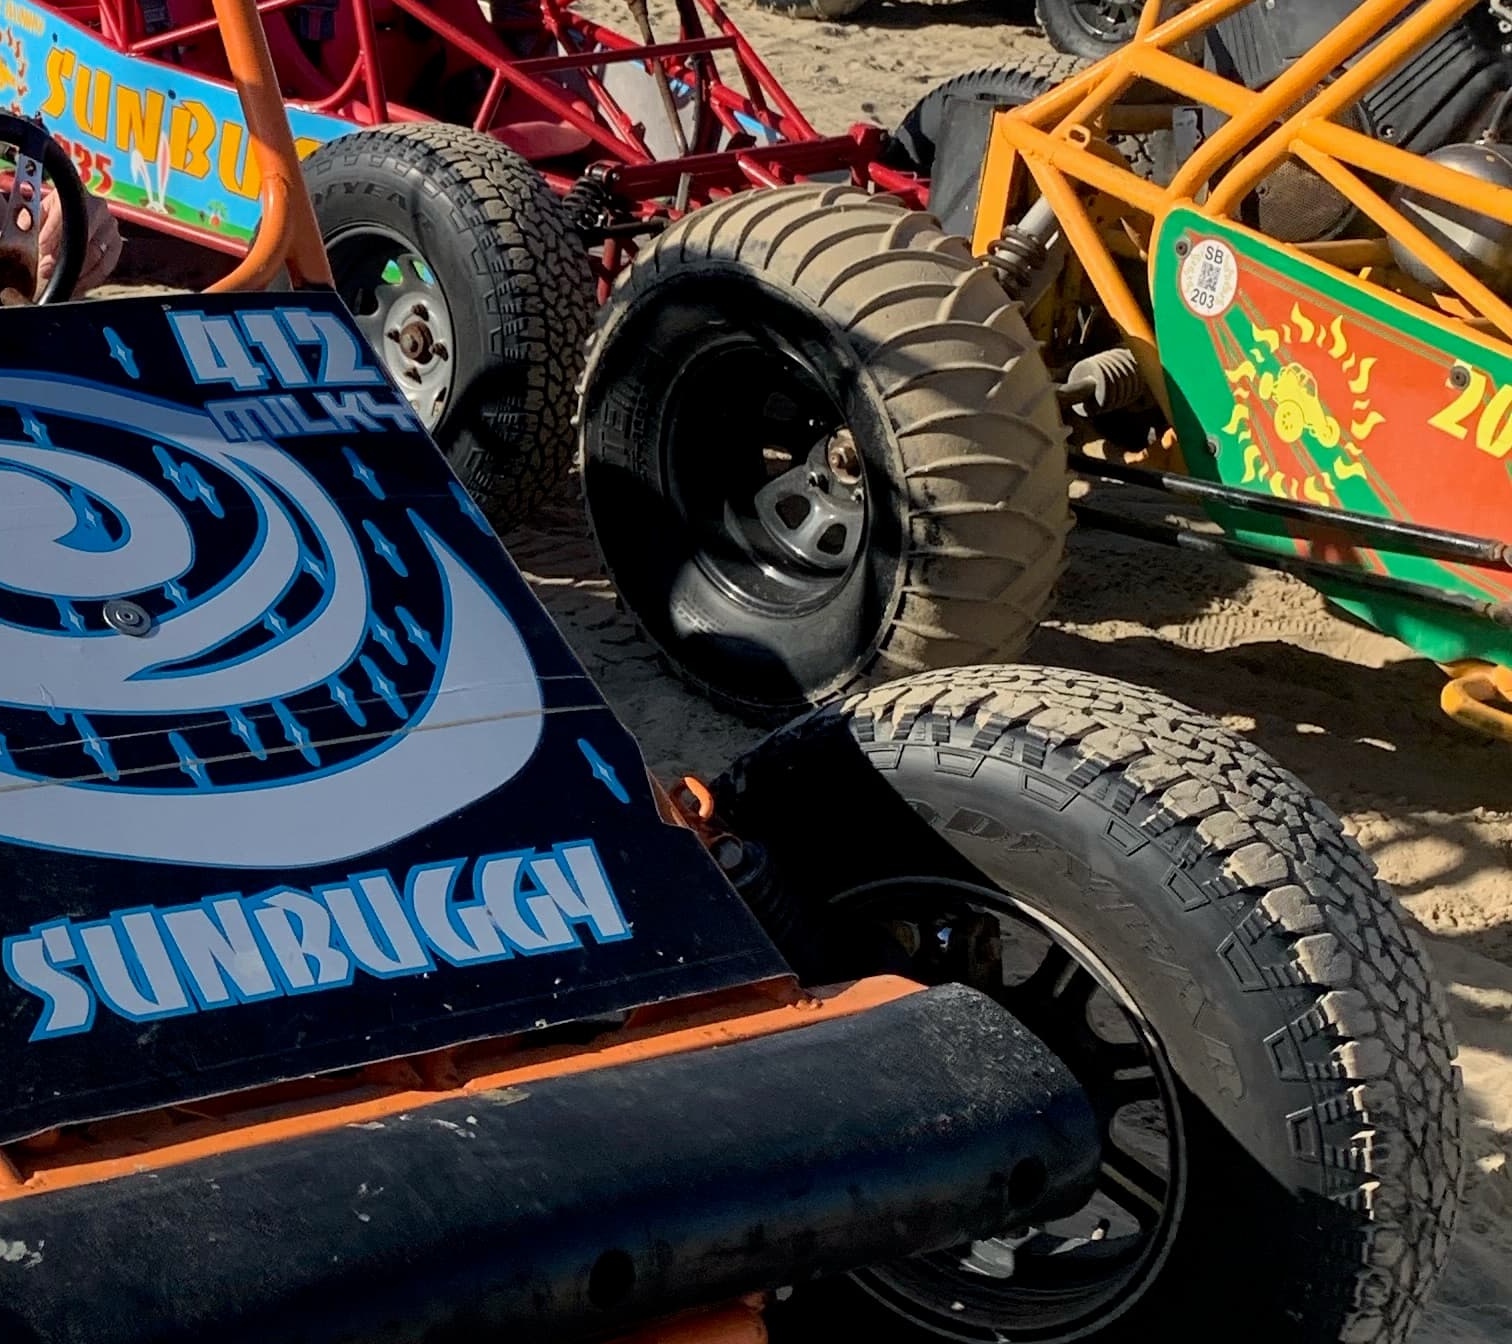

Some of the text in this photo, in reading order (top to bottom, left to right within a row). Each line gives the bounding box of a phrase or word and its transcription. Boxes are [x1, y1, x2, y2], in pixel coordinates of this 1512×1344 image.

[1205, 246, 1224, 265] SB
[1190, 288, 1216, 309] 203
[165, 306, 387, 391] 412
[204, 391, 419, 443] MILKY
[2, 838, 634, 1044] SUNBUGGY
